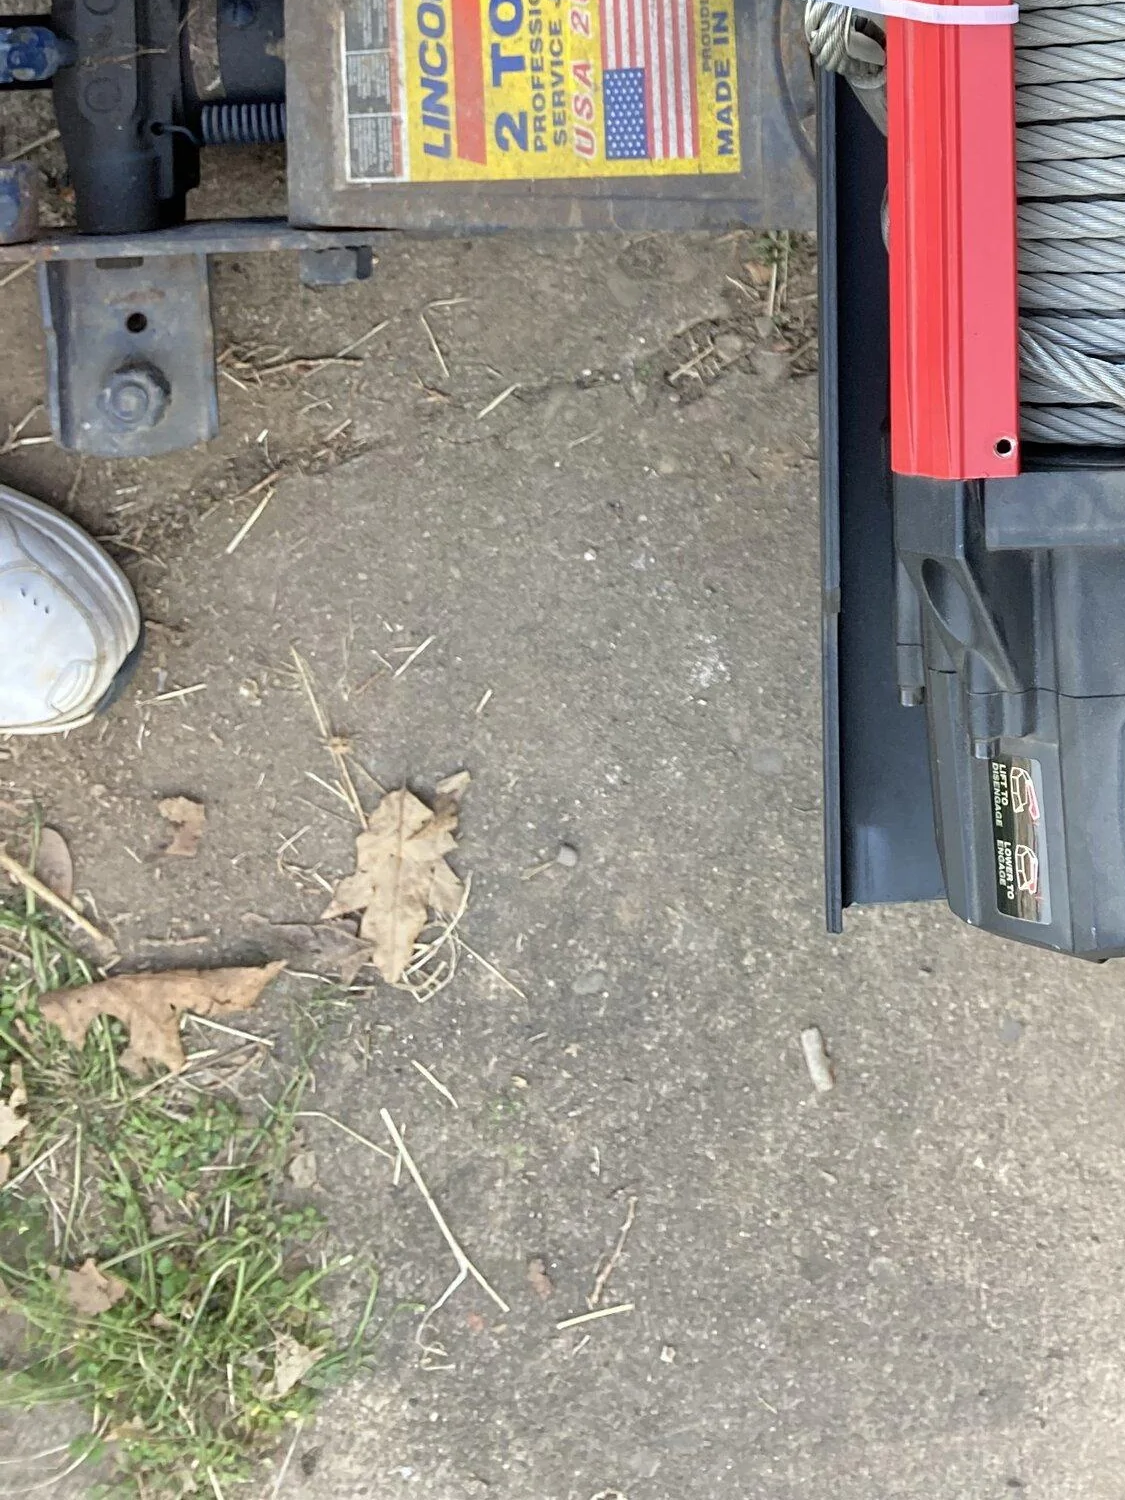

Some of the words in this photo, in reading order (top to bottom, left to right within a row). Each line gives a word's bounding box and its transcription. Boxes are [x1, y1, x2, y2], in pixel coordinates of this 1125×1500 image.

[714, 11, 729, 48] IN
[544, 19, 567, 145] SERVICE
[571, 62, 596, 157] USA
[714, 58, 733, 155] MADE
[495, 112, 528, 153] 2
[992, 762, 1003, 827] DISENGAGE
[1002, 790, 1008, 806] TO
[997, 840, 1006, 886] ENGAGE
[1004, 842, 1014, 881] LOWER
[1007, 882, 1014, 900] TO
